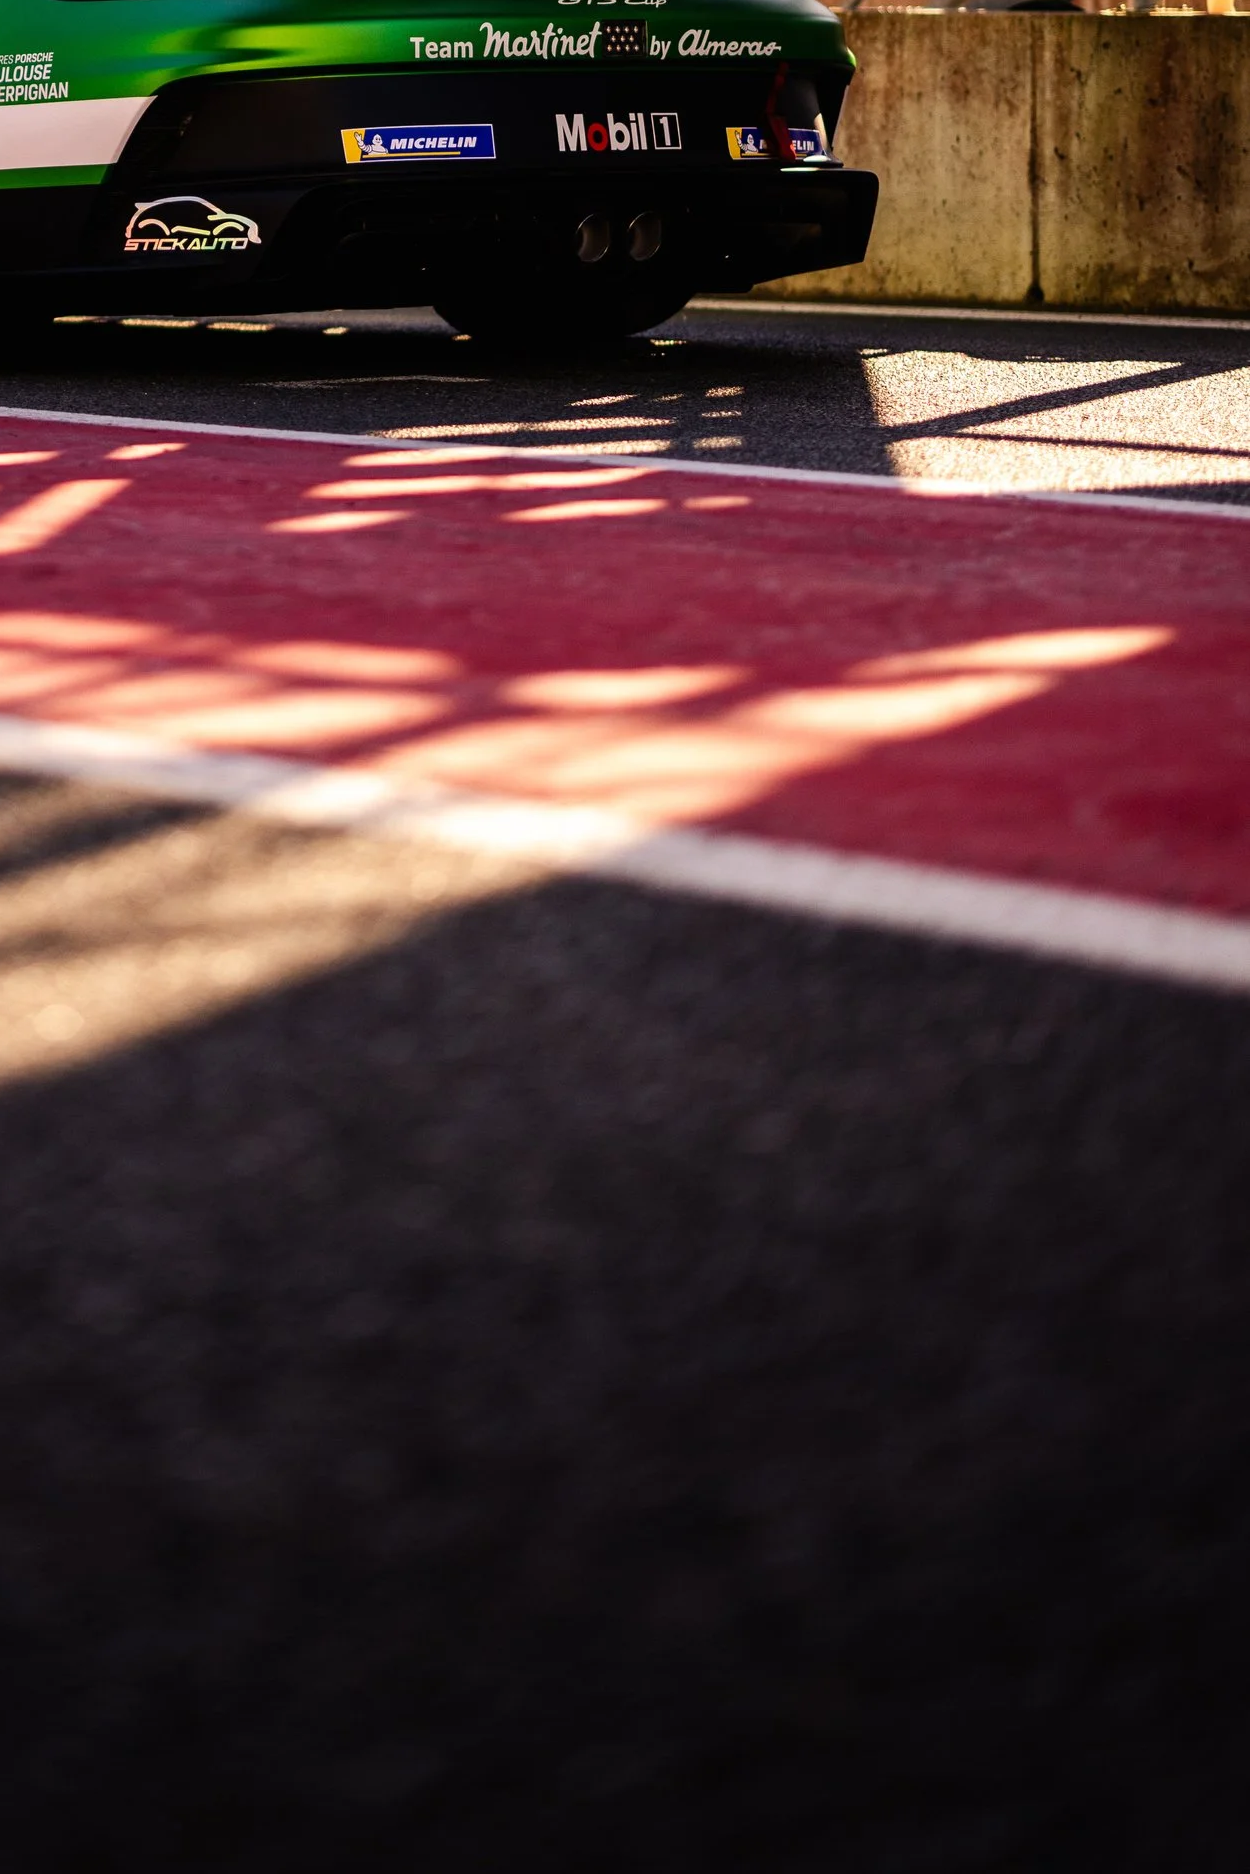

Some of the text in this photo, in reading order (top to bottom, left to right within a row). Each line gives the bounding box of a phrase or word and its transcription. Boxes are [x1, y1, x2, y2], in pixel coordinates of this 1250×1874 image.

[409, 36, 474, 59] Team
[479, 21, 602, 59] Martinet
[649, 35, 671, 60] by
[14, 52, 54, 64] PORSCHE
[389, 136, 478, 150] MICHELIN
[555, 113, 648, 152] Mobil
